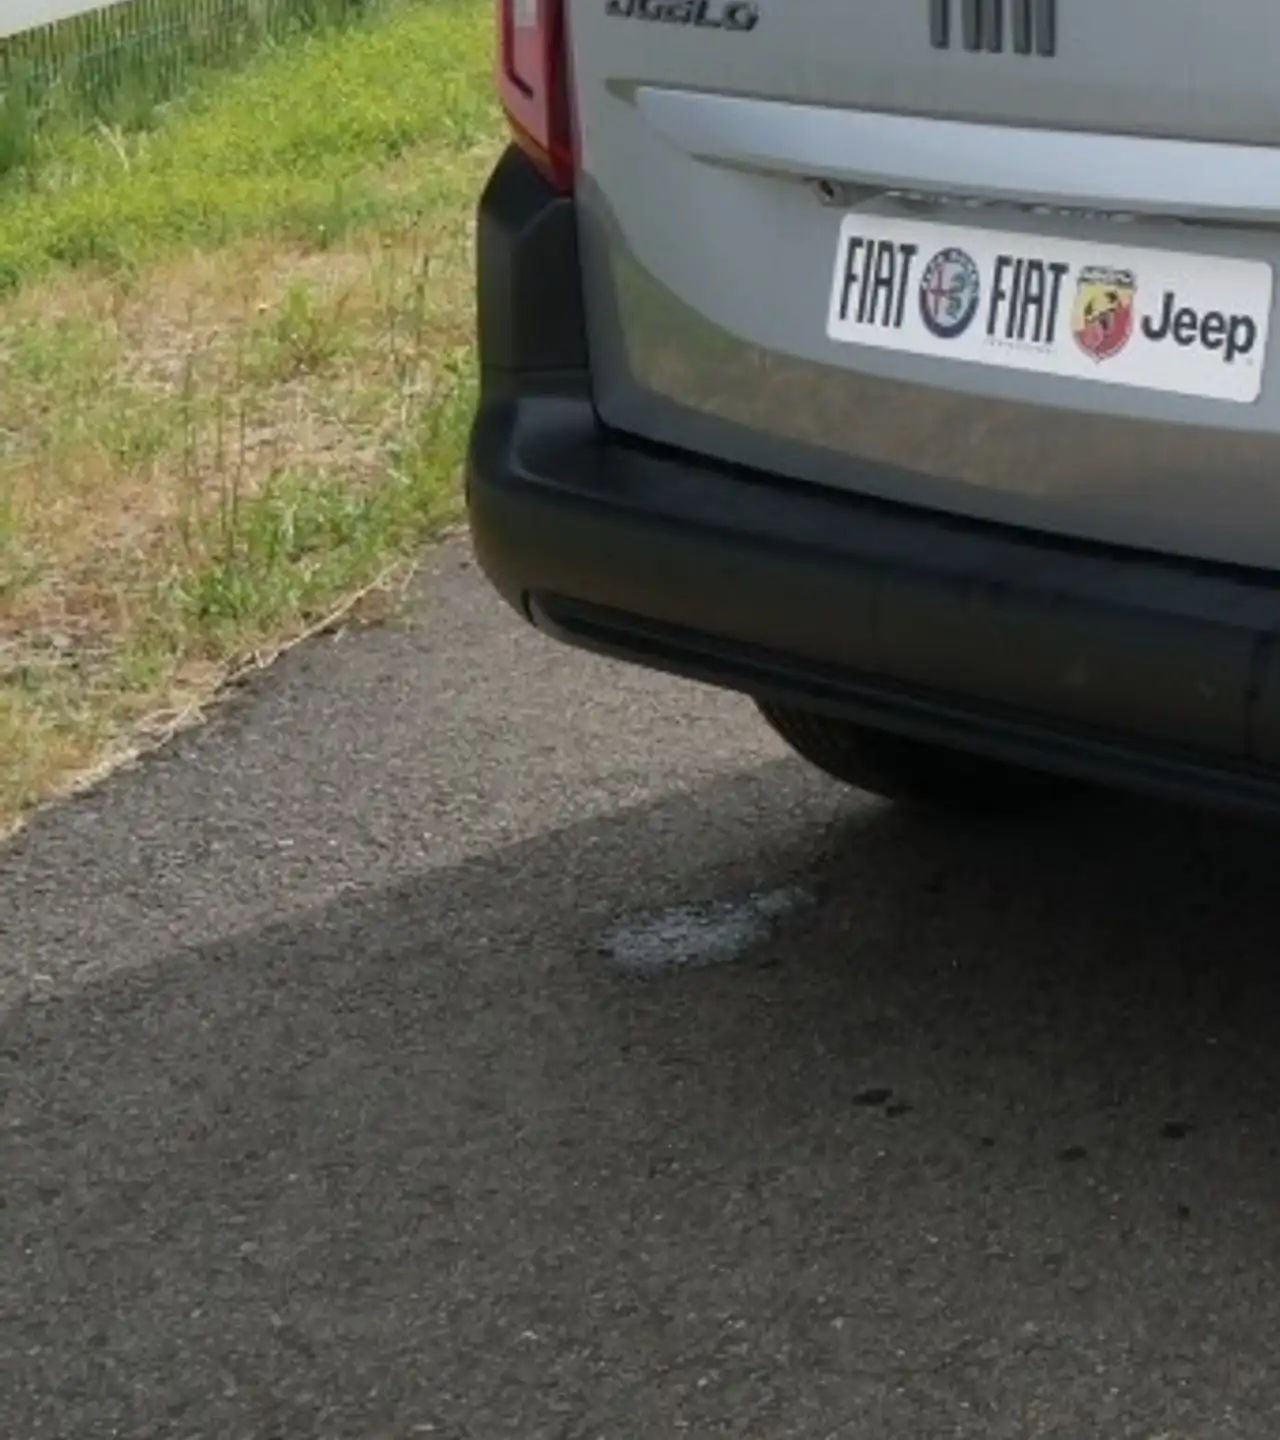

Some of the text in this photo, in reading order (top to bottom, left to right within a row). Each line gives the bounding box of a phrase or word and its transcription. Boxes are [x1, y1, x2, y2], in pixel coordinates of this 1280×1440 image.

[839, 236, 918, 328] FIAT
[987, 254, 1069, 344] FIAT
[1141, 291, 1257, 363] Jeep
